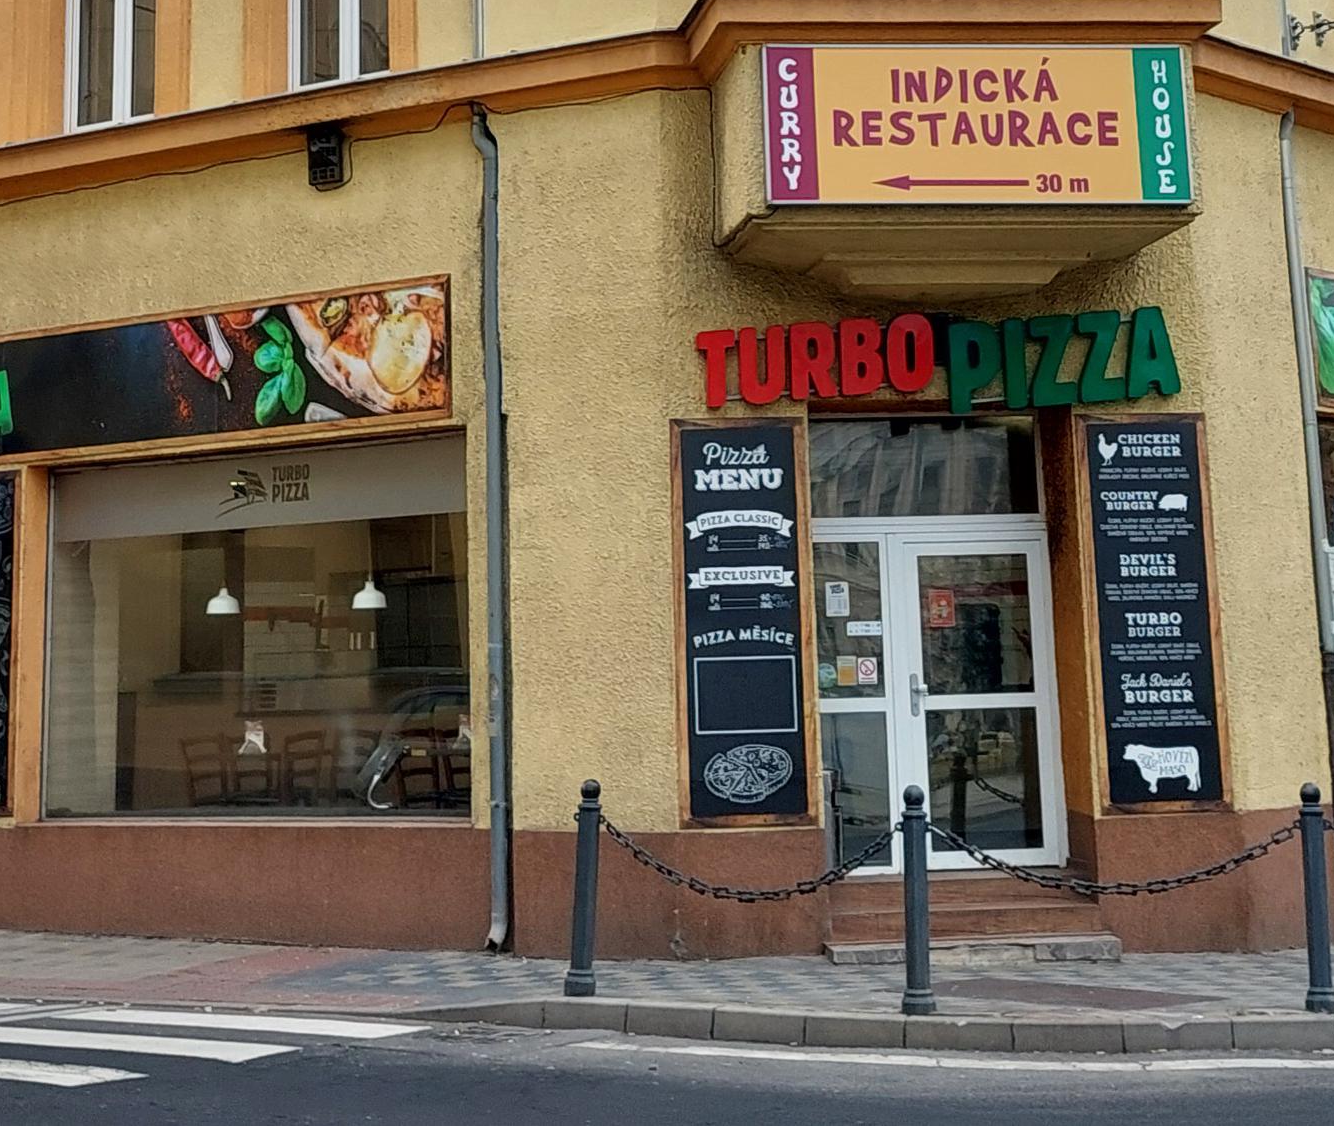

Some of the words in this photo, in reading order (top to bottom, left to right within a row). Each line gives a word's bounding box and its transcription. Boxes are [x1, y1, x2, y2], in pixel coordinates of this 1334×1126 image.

[890, 56, 1059, 104] INDICKÁ
[778, 57, 802, 191] CURRY
[832, 108, 1120, 148] RESTAURACE
[1151, 59, 1177, 194] HOUSE
[1035, 174, 1063, 194] 30
[1069, 177, 1090, 193] m
[696, 312, 934, 410] TURBO
[948, 305, 1182, 415] PIZZA
[1117, 434, 1181, 445] CHICKEN
[703, 442, 770, 466] Pizza
[1122, 446, 1182, 458] BURGER
[271, 463, 310, 483] TURBO
[694, 468, 784, 492] MENU
[271, 482, 310, 503] PIZZA
[1100, 491, 1159, 501] COUNTRY
[1106, 501, 1155, 511] BURGER
[700, 514, 732, 529] PIZZA
[734, 513, 780, 527] CLASSIC
[704, 569, 781, 582] EXCLUSIVE
[1120, 566, 1177, 577] BURGER
[1124, 612, 1183, 625] TURBO
[693, 629, 735, 649] PIZZA
[739, 625, 795, 647] MĚSÍCE
[1127, 626, 1182, 638] BURGER
[1120, 672, 1148, 690] Jack
[1124, 690, 1195, 704] BURGER
